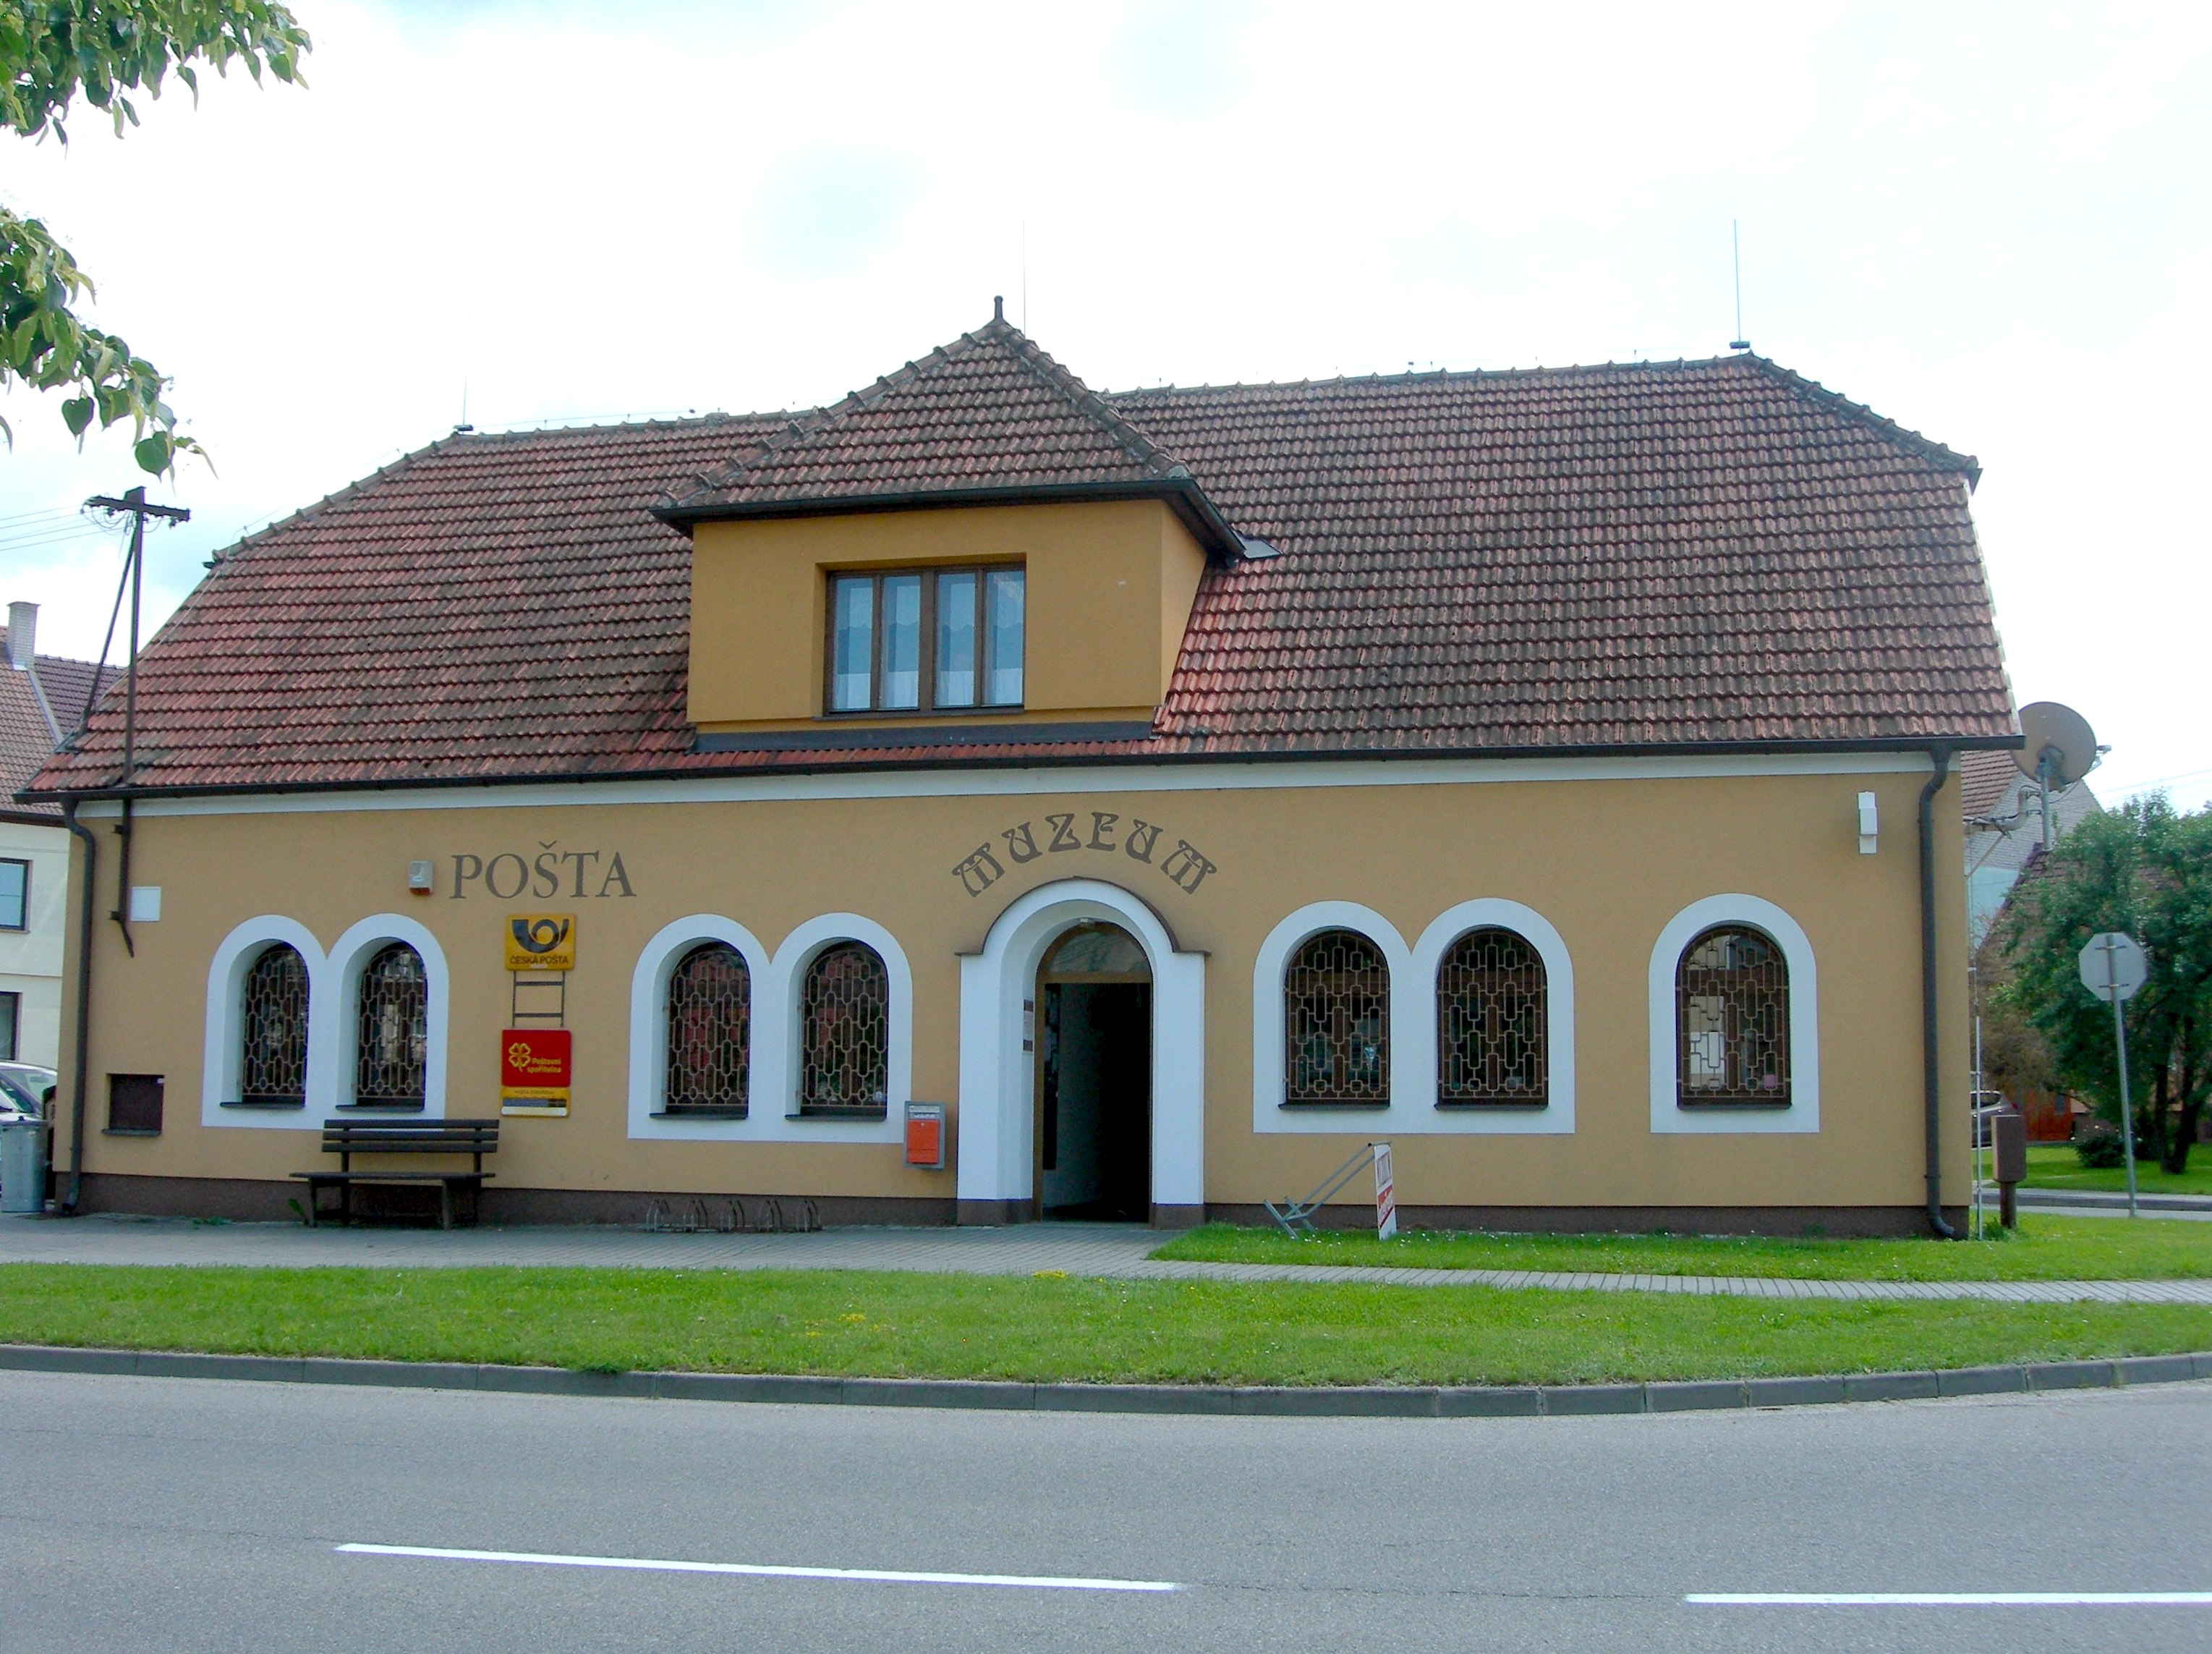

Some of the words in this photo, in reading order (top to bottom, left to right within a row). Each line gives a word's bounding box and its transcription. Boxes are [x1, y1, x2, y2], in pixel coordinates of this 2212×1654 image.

[449, 840, 637, 899] POŠTA
[952, 812, 1217, 897] MUZEUM
[510, 954, 537, 964] ČESKÁ
[540, 954, 569, 964] POŠTA
